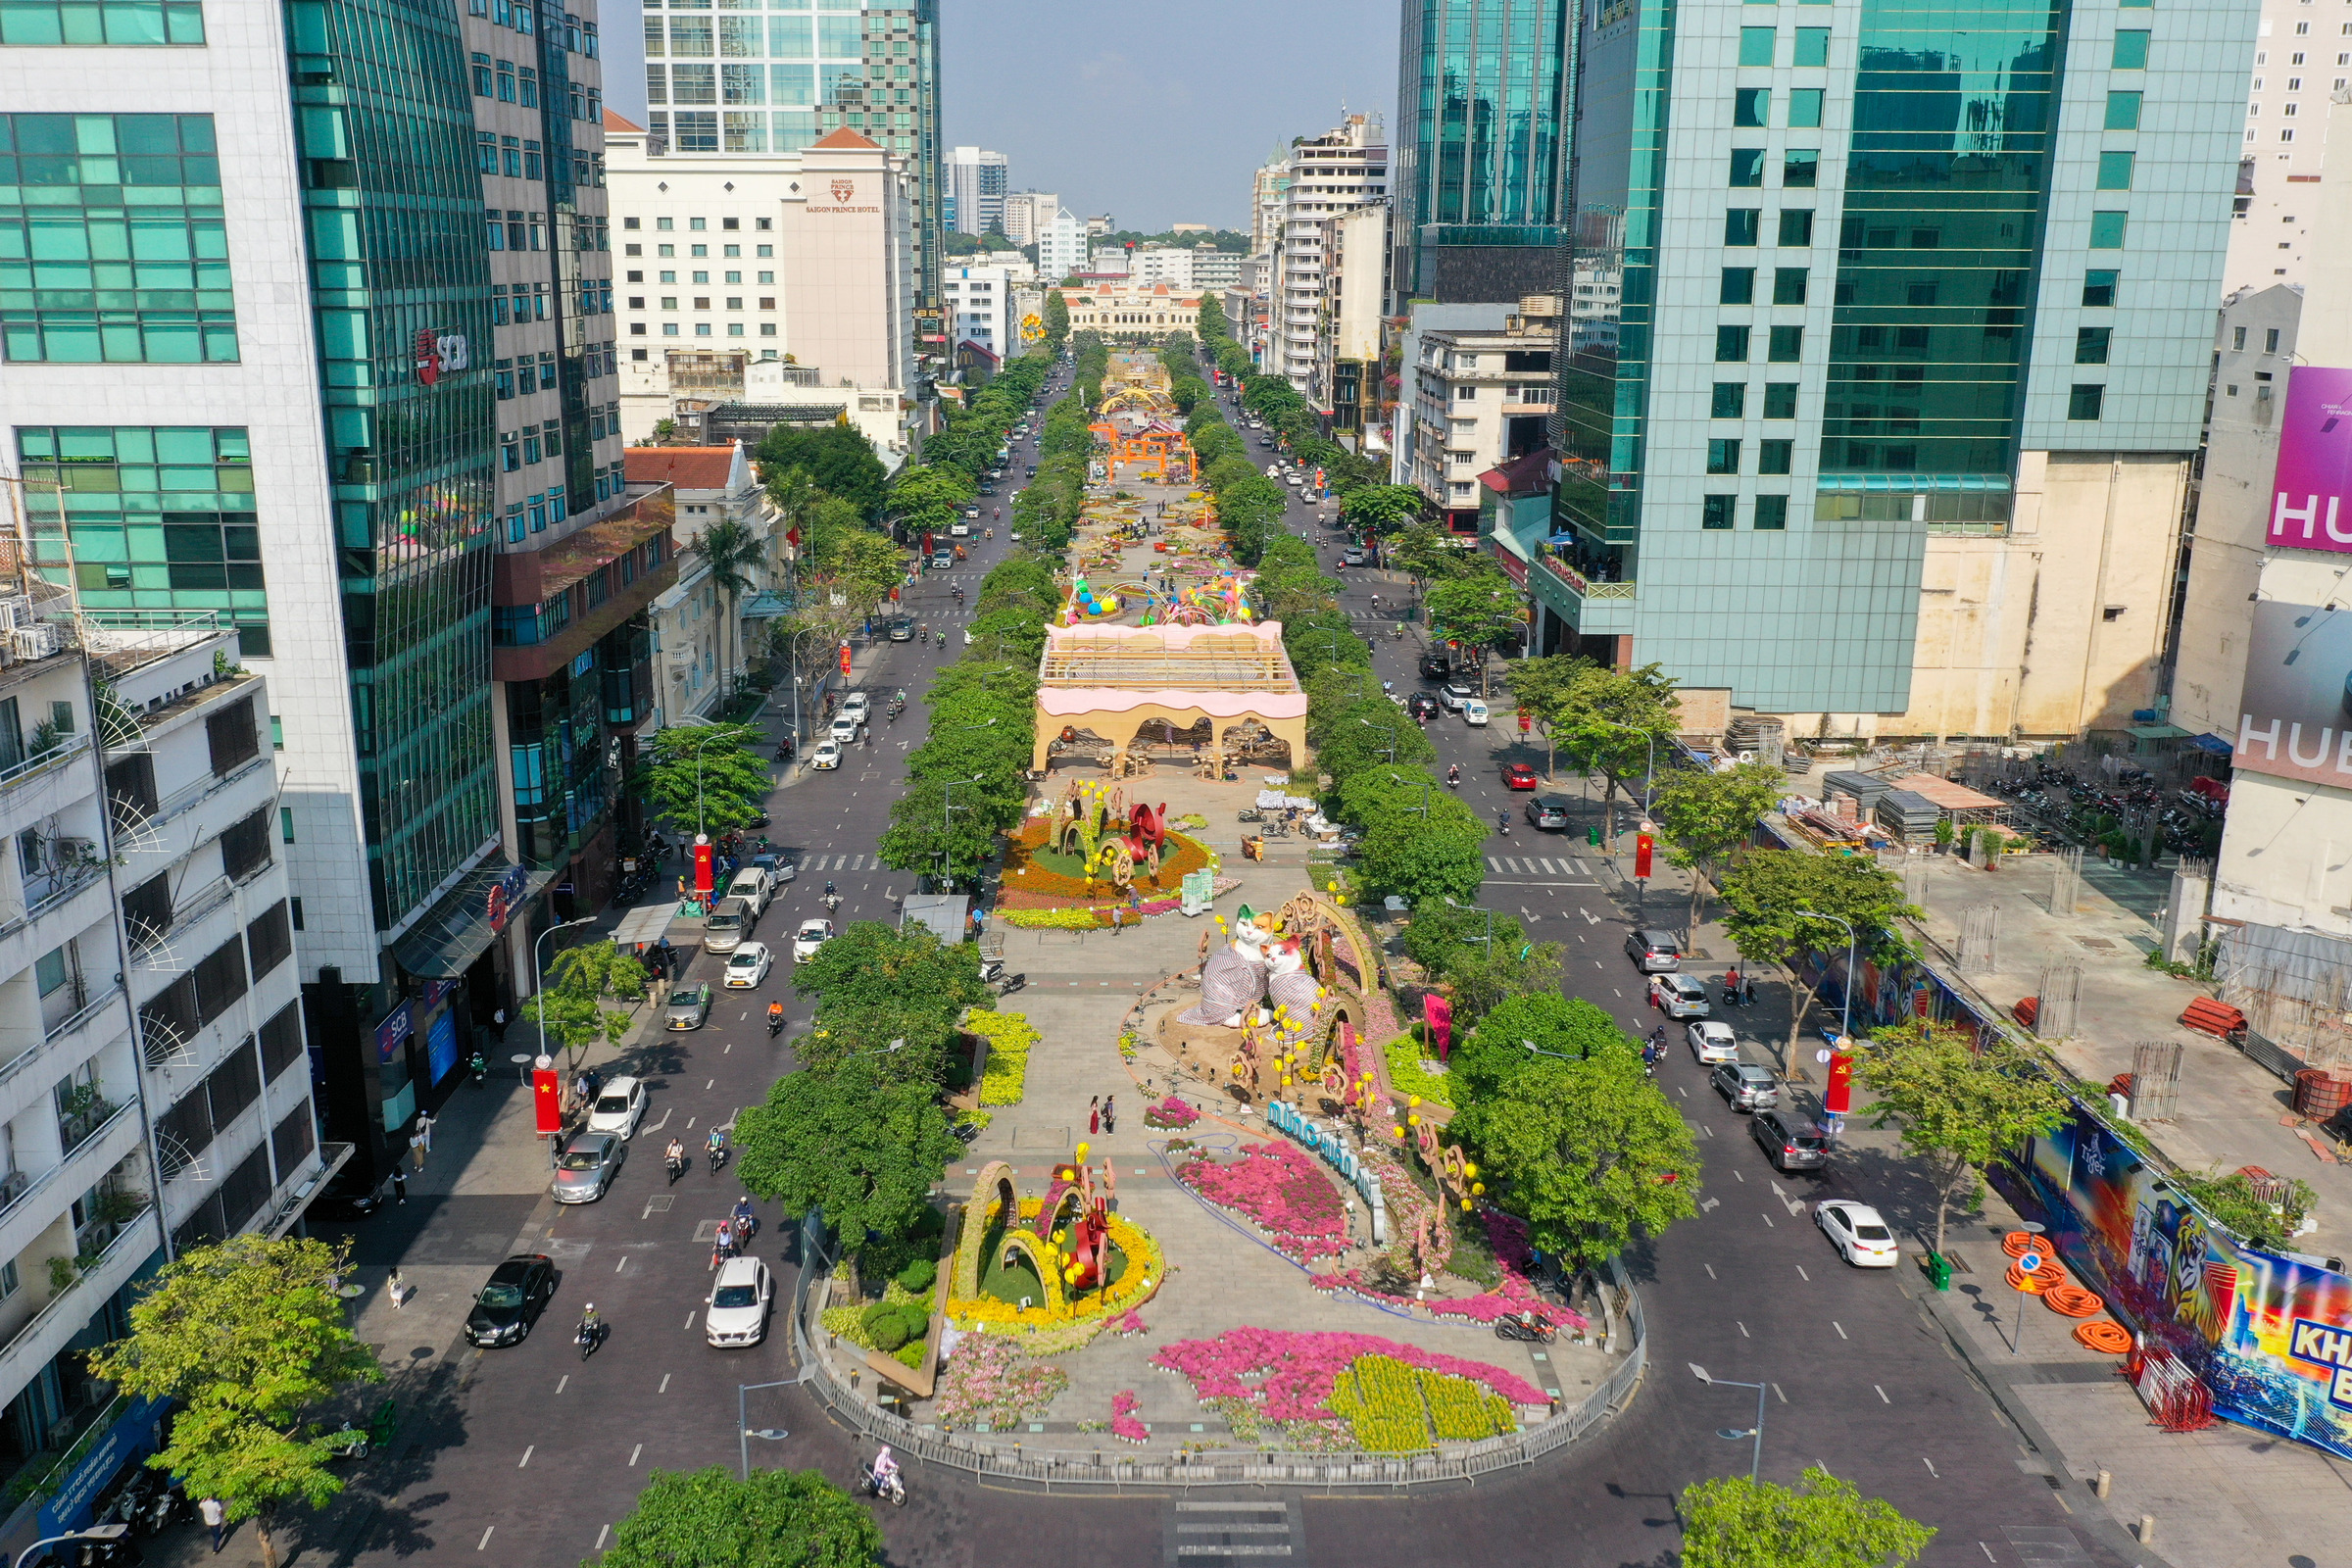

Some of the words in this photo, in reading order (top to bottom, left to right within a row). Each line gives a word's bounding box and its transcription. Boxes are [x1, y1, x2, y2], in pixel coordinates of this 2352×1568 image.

[437, 334, 468, 372] SCB
[391, 1010, 408, 1038] SCB
[2081, 1144, 2107, 1176] Tiger
